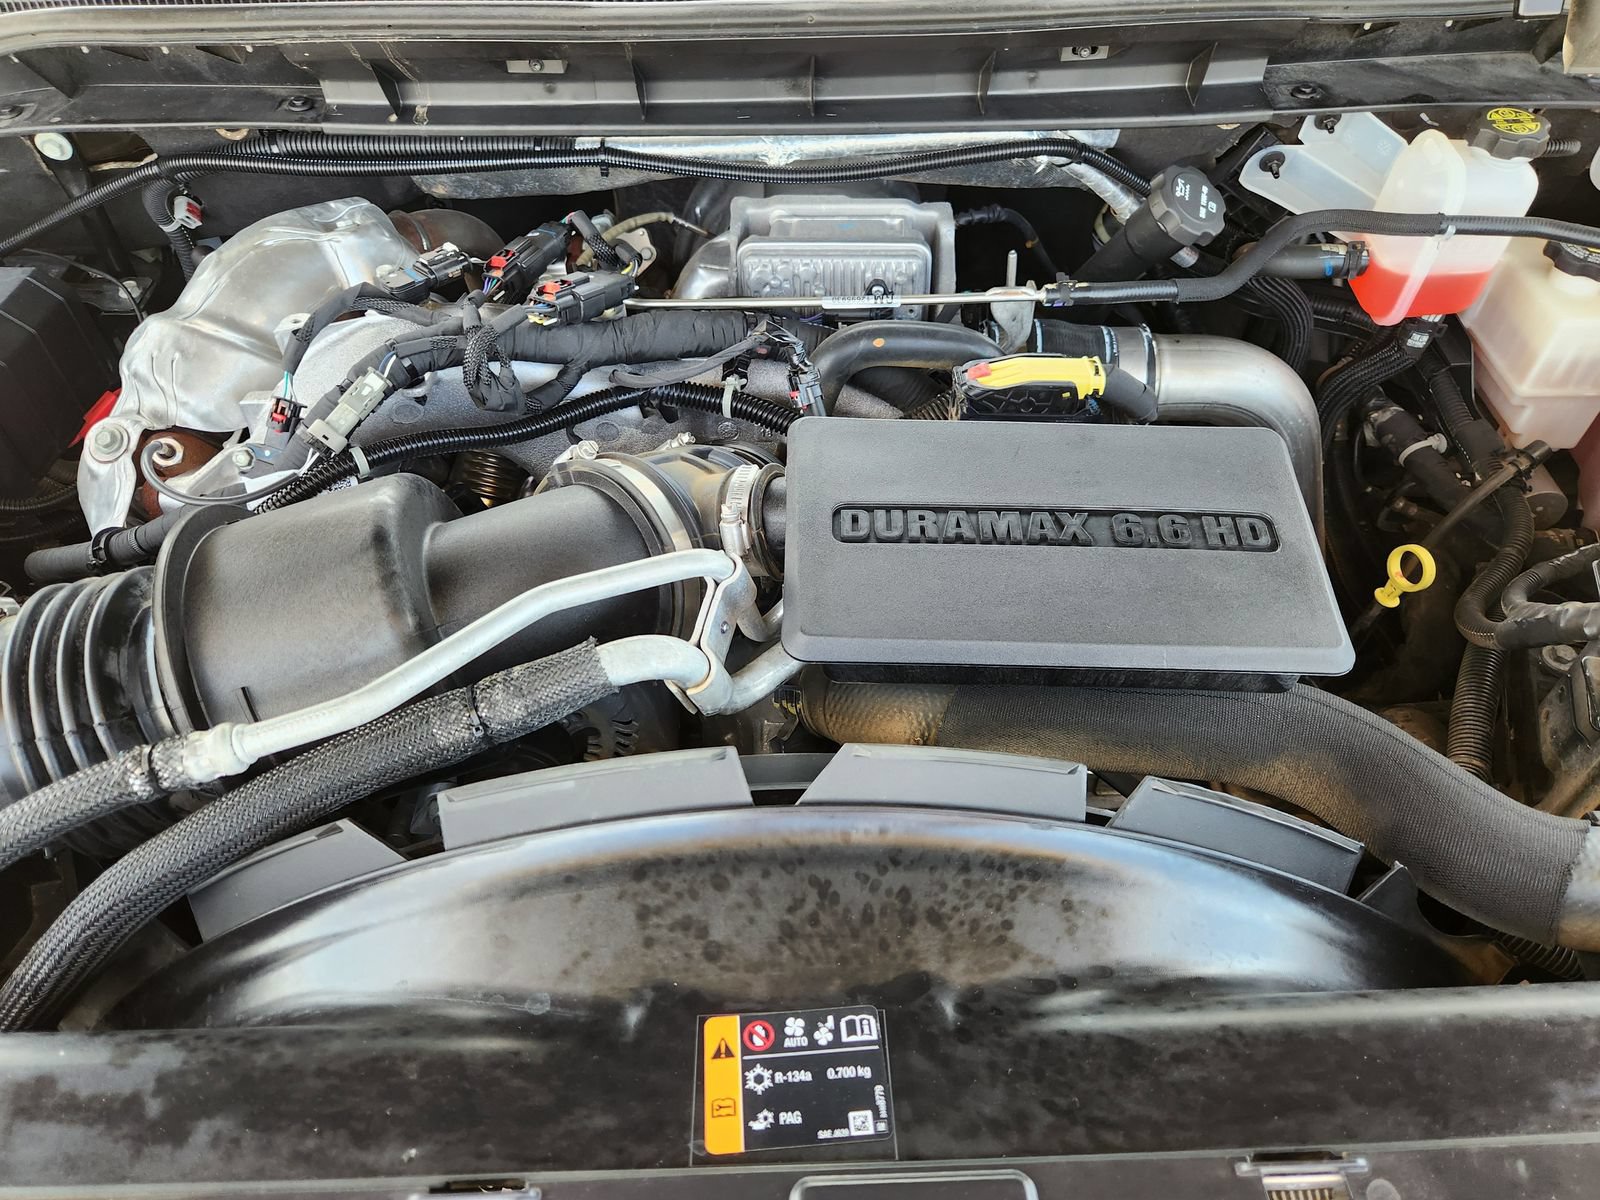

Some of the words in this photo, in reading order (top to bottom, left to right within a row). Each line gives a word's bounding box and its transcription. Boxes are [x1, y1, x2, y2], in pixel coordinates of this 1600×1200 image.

[839, 508, 1094, 545] DURAMAX
[1111, 512, 1193, 546] 6.6
[1201, 515, 1272, 548] HD
[783, 1036, 809, 1048] AUTO
[774, 1069, 813, 1084] R-134a
[826, 1065, 857, 1080] 0.700
[857, 1064, 872, 1079] kg
[779, 1110, 803, 1125] PAG
